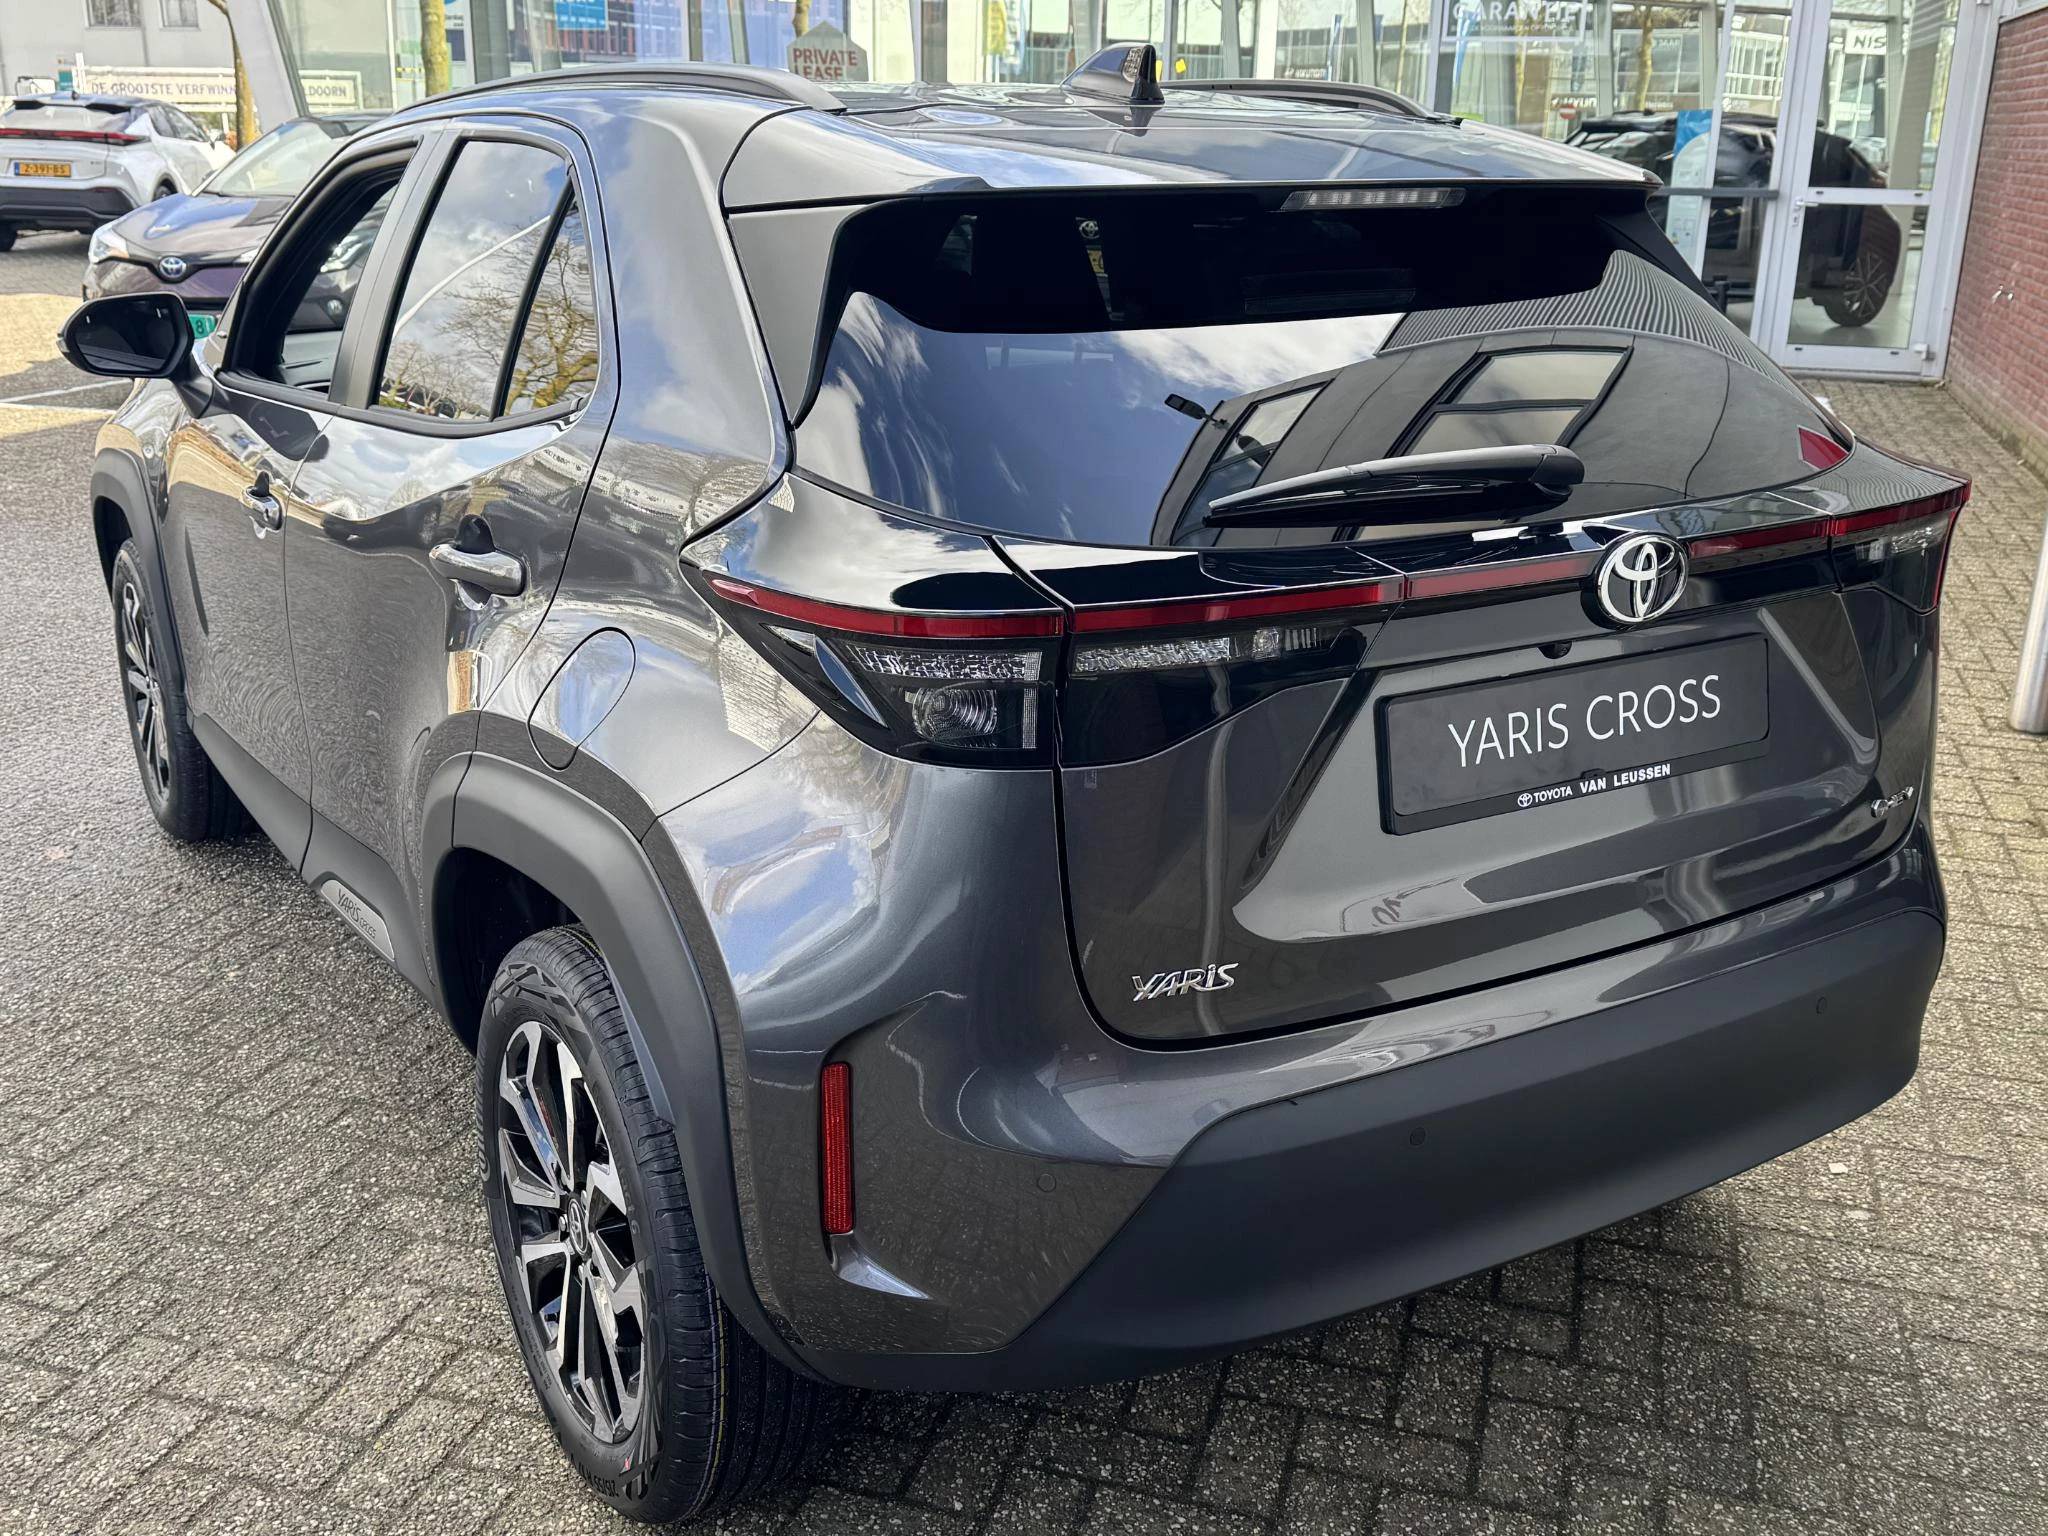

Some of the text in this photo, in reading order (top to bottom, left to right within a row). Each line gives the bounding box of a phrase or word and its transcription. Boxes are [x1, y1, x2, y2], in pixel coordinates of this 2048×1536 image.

[793, 48, 857, 66] PRIVATE
[92, 82, 106, 95] DE
[304, 86, 346, 96] DOORN
[1448, 674, 1721, 767] YARIS CROSS
[1533, 764, 1671, 803] TOYOTA VAN LEUSSEN
